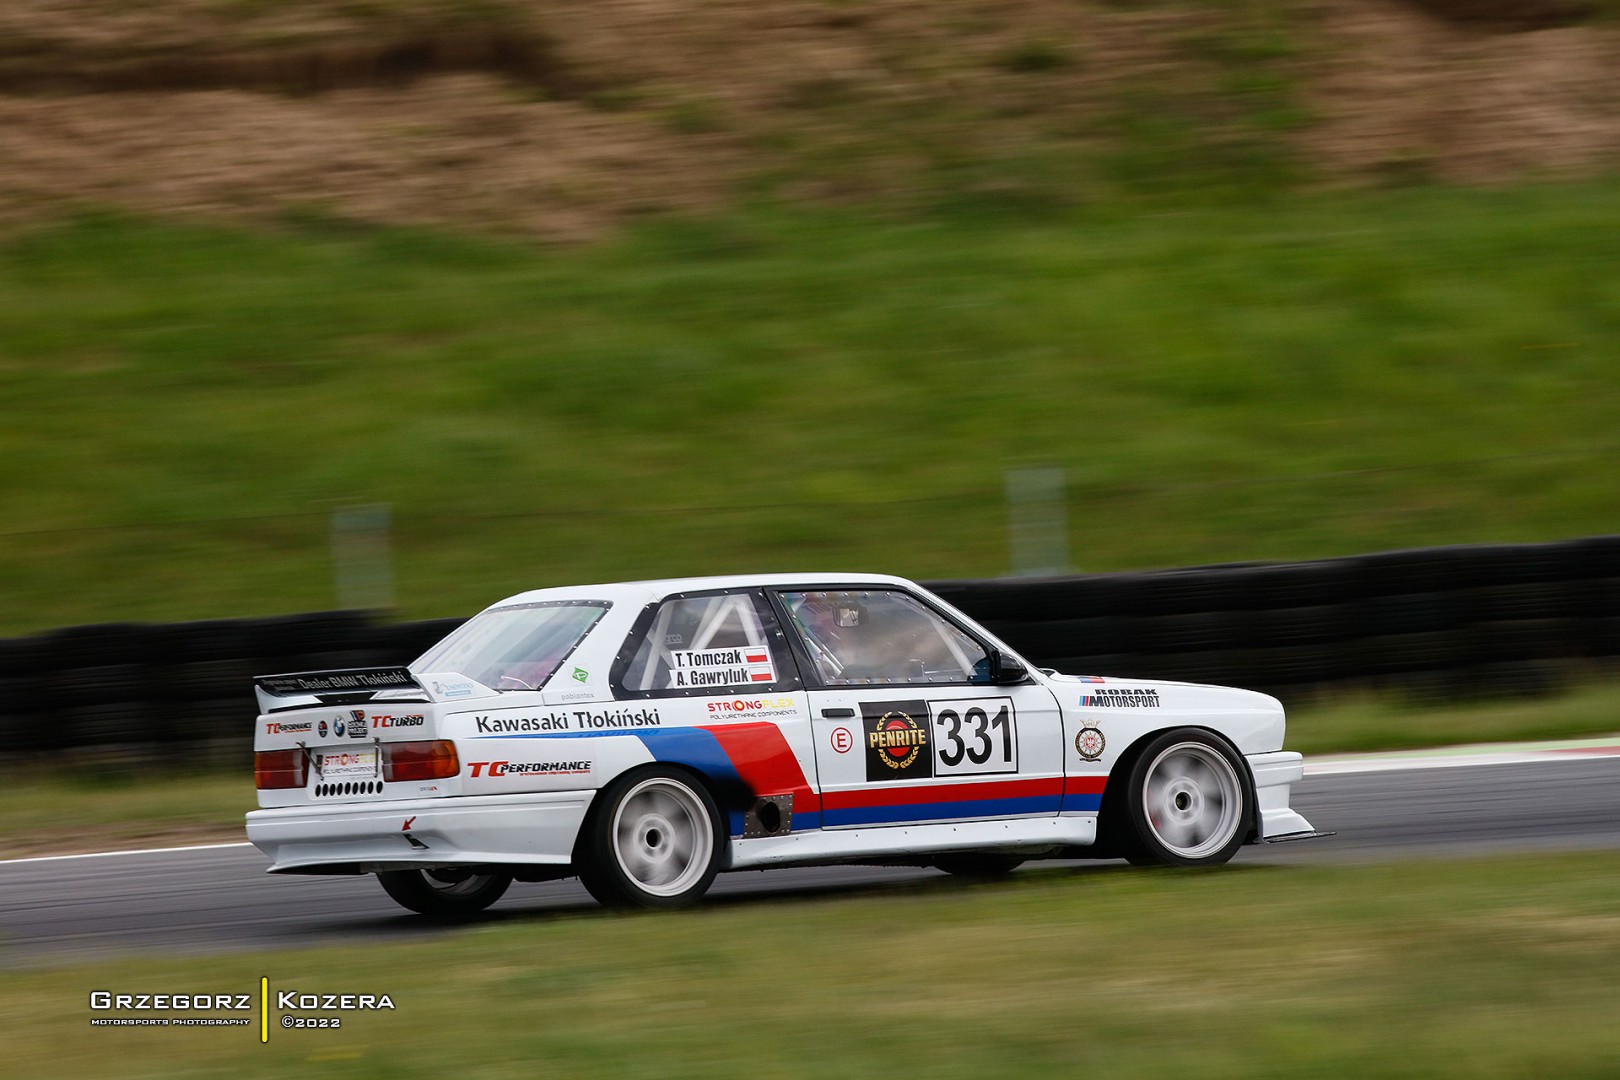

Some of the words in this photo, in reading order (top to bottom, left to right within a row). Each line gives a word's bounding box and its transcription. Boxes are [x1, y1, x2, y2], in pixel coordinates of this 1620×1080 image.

[675, 653, 685, 667] T.
[688, 650, 742, 666] Tomczak
[297, 678, 332, 689] Dealer
[328, 675, 360, 688] BMW
[677, 671, 688, 686] A.
[691, 668, 748, 686] Gawryluk
[707, 698, 795, 712] STRONGFLEX
[1089, 696, 1160, 707] MOTORSPORT
[475, 713, 569, 733] Kawasaki
[572, 708, 661, 729] Tłokiński
[710, 712, 757, 720] POLYURETHANE
[758, 709, 798, 717] COMPONENTS
[869, 729, 927, 749] PENRITE
[937, 705, 1012, 767] 331
